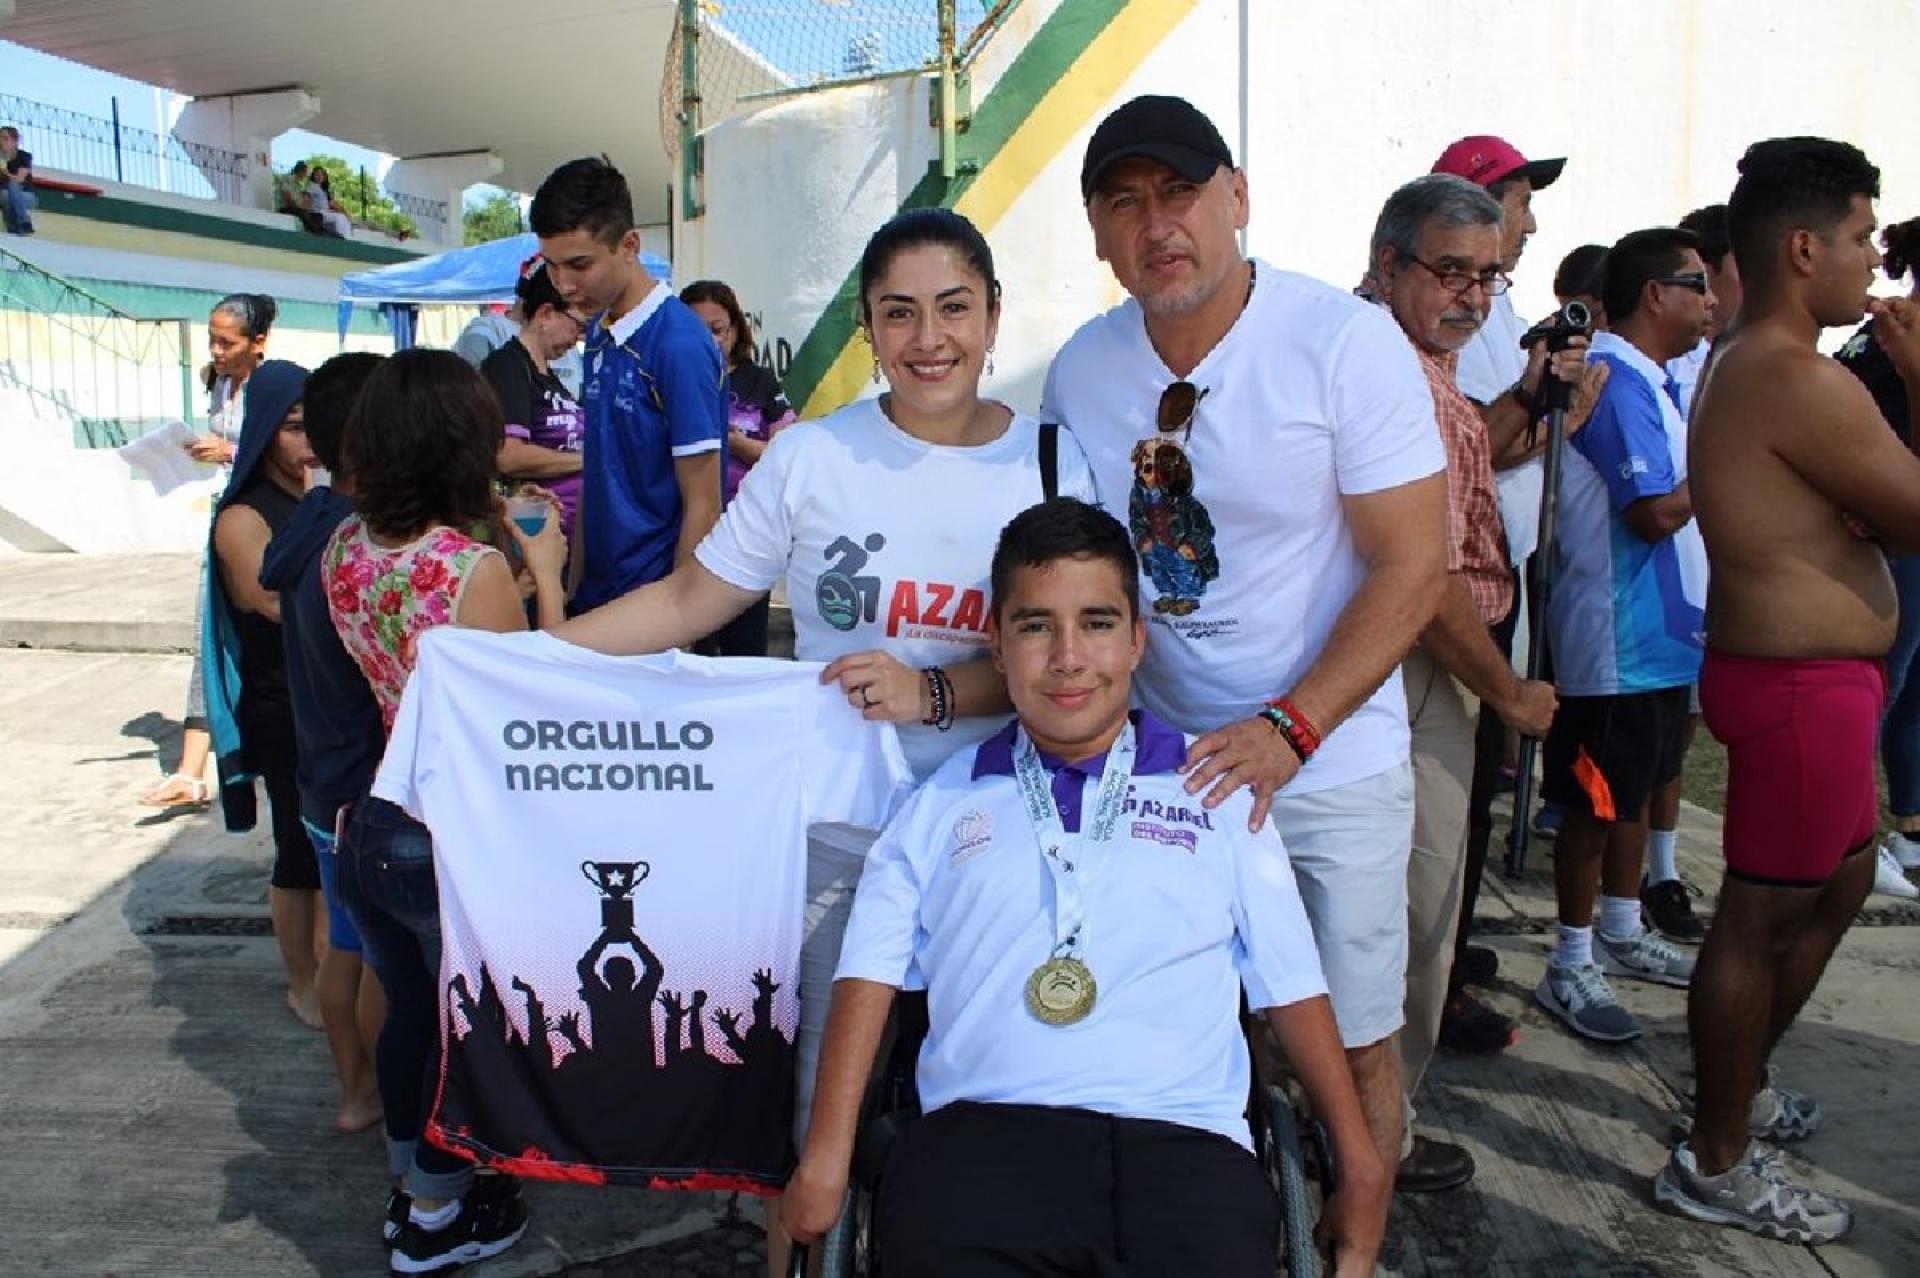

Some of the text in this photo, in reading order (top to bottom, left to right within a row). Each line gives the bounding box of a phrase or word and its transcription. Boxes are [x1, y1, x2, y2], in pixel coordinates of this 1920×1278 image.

[886, 580, 993, 638] AZA
[503, 720, 714, 751] ORGULLO
[505, 763, 714, 791] NACIONAL
